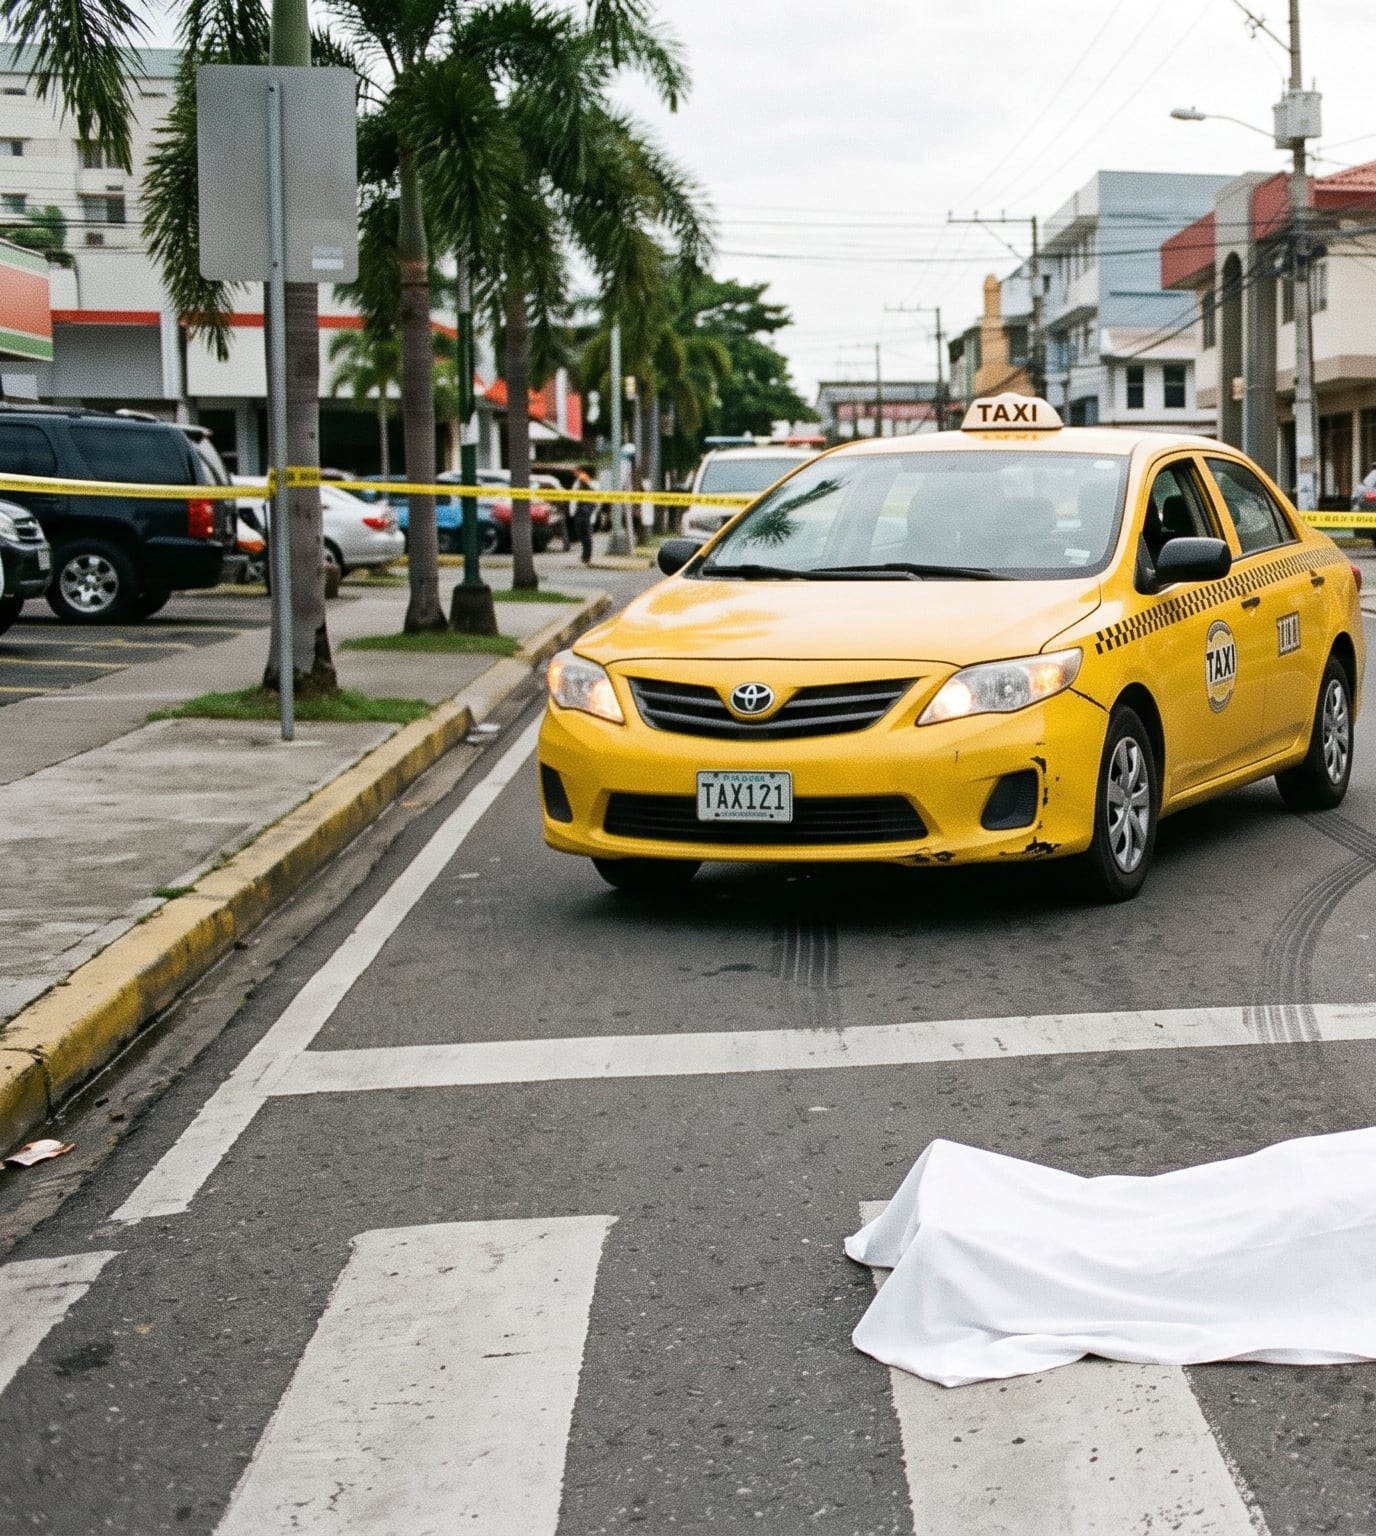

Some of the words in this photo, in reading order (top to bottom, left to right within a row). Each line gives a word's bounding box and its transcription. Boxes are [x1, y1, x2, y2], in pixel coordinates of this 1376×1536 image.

[977, 404, 1037, 422] TAXI
[1206, 644, 1235, 683] TAXI
[702, 783, 784, 810] TAX121
